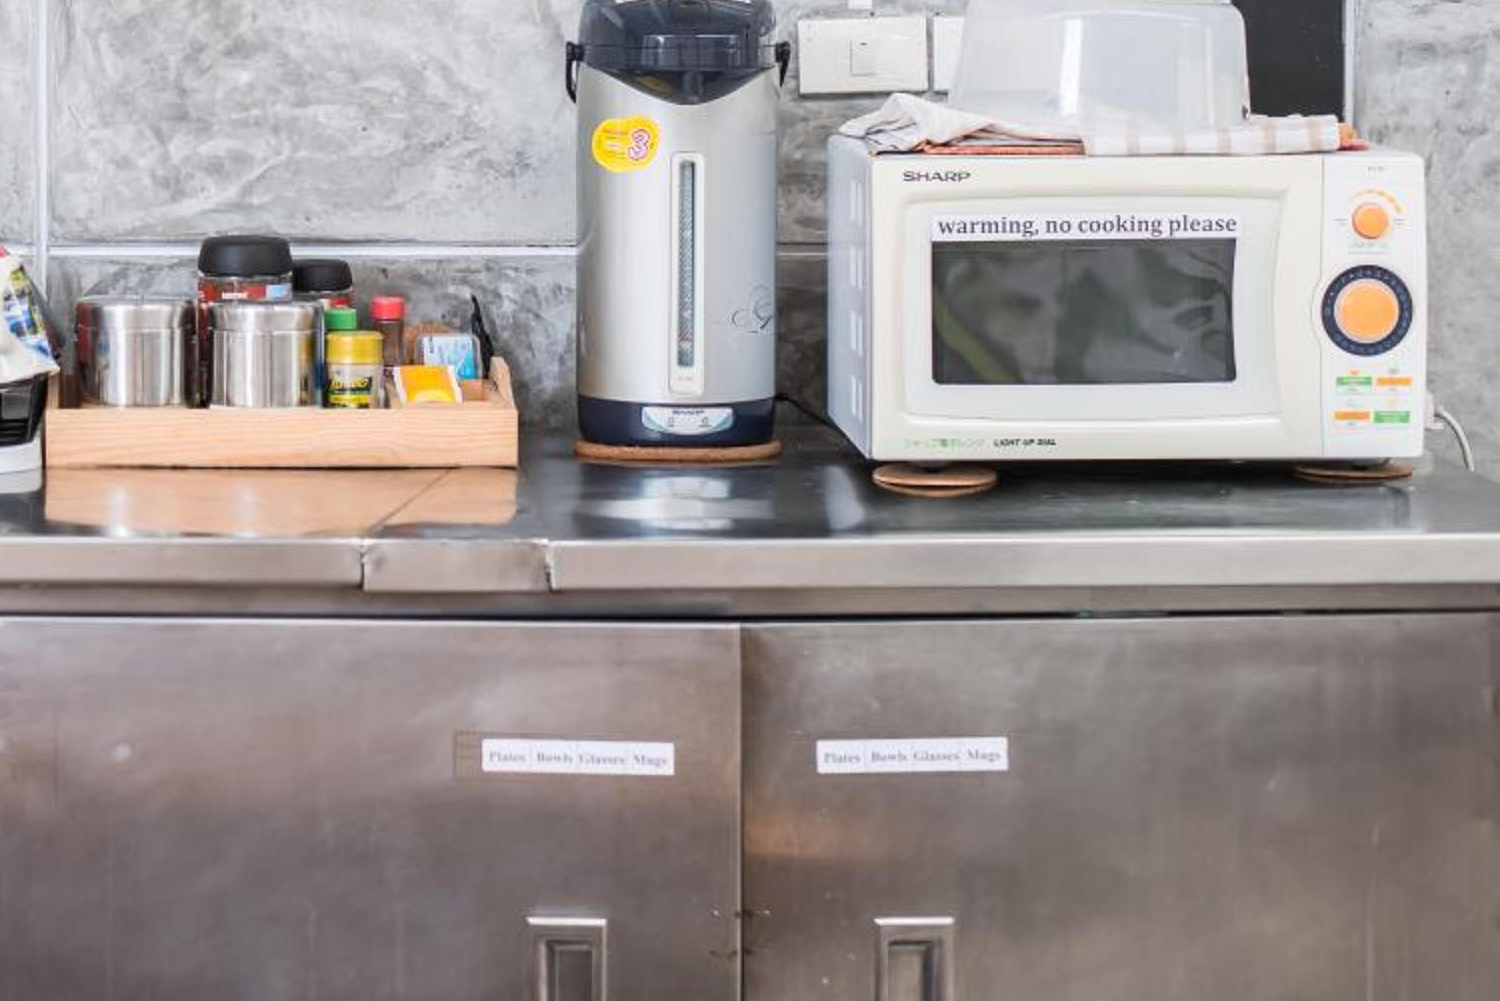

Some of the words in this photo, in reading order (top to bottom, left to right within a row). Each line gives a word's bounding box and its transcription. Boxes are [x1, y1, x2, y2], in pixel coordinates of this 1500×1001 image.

[628, 128, 651, 161] 3
[903, 171, 971, 181] SHARP
[938, 217, 1039, 236] warming,
[1045, 218, 1072, 233] no
[1077, 216, 1163, 236] cooking
[1168, 214, 1237, 235] please
